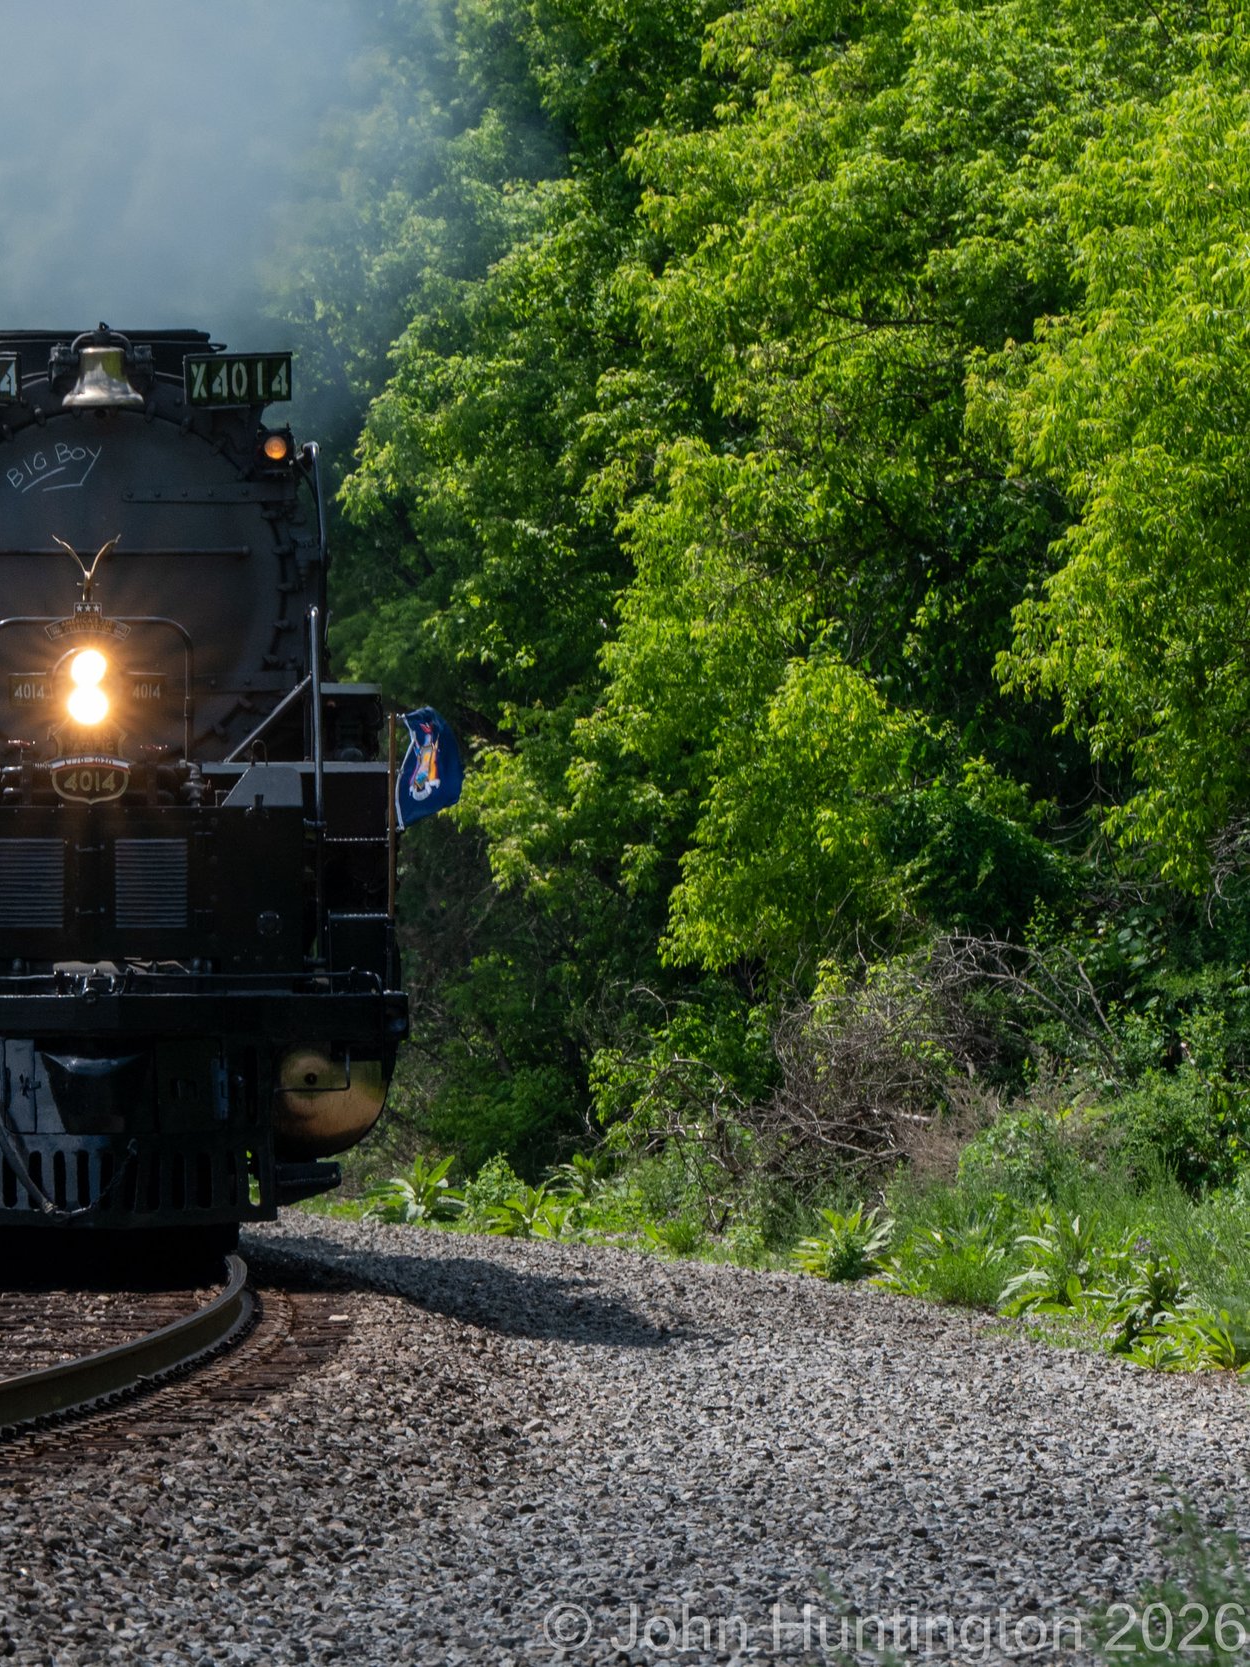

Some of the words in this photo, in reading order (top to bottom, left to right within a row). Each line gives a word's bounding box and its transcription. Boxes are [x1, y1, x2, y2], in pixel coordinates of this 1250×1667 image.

[190, 361, 289, 399] X4014
[6, 451, 47, 488] BIG
[14, 683, 46, 699] 4014
[132, 683, 161, 699] 4014
[63, 770, 116, 792] 4014
